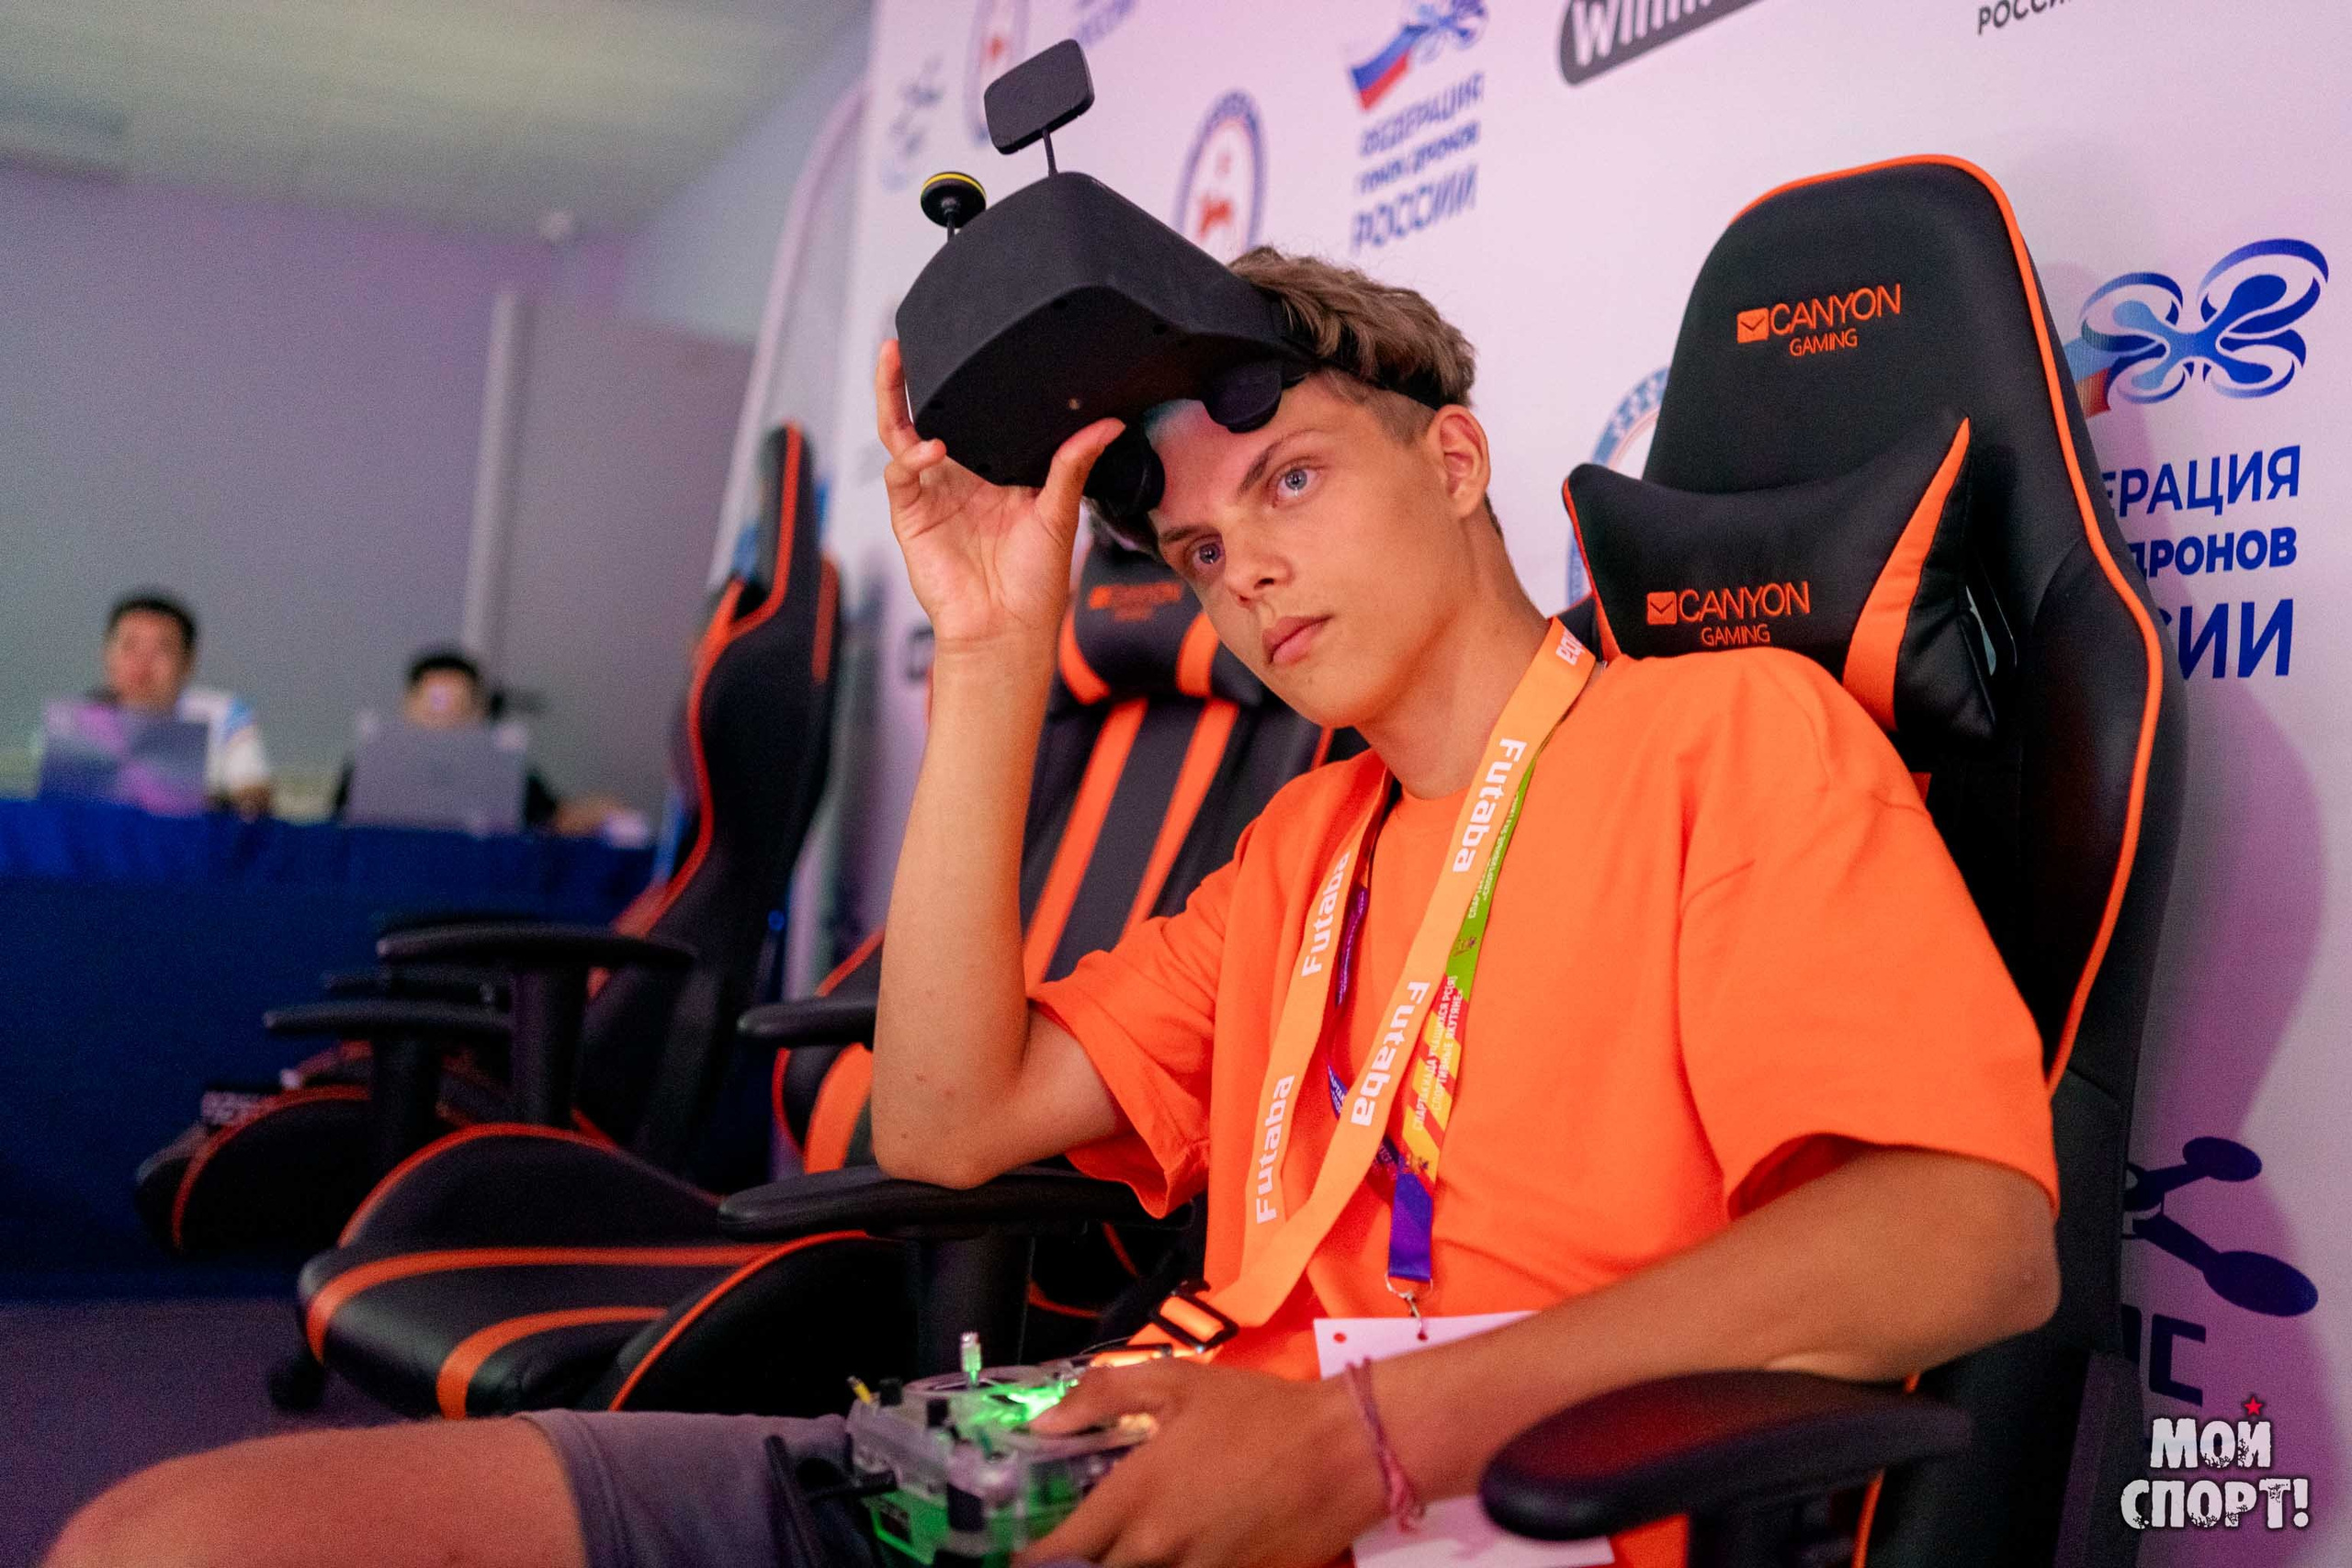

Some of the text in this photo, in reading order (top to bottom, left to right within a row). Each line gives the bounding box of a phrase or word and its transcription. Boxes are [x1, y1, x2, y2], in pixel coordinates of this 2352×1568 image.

[1977, 0, 2065, 36] РОСС
[1351, 164, 1478, 255] РОССИИ
[1770, 283, 1901, 336] CANYON
[1789, 327, 1858, 357] GAMING
[1679, 581, 1811, 623] CANYON
[1701, 623, 1771, 648] GAMING
[1453, 738, 1528, 873] Futaba
[1301, 851, 1351, 977] Futaba
[1350, 981, 1430, 1126] Futaba
[1255, 1075, 1295, 1224] Futaba
